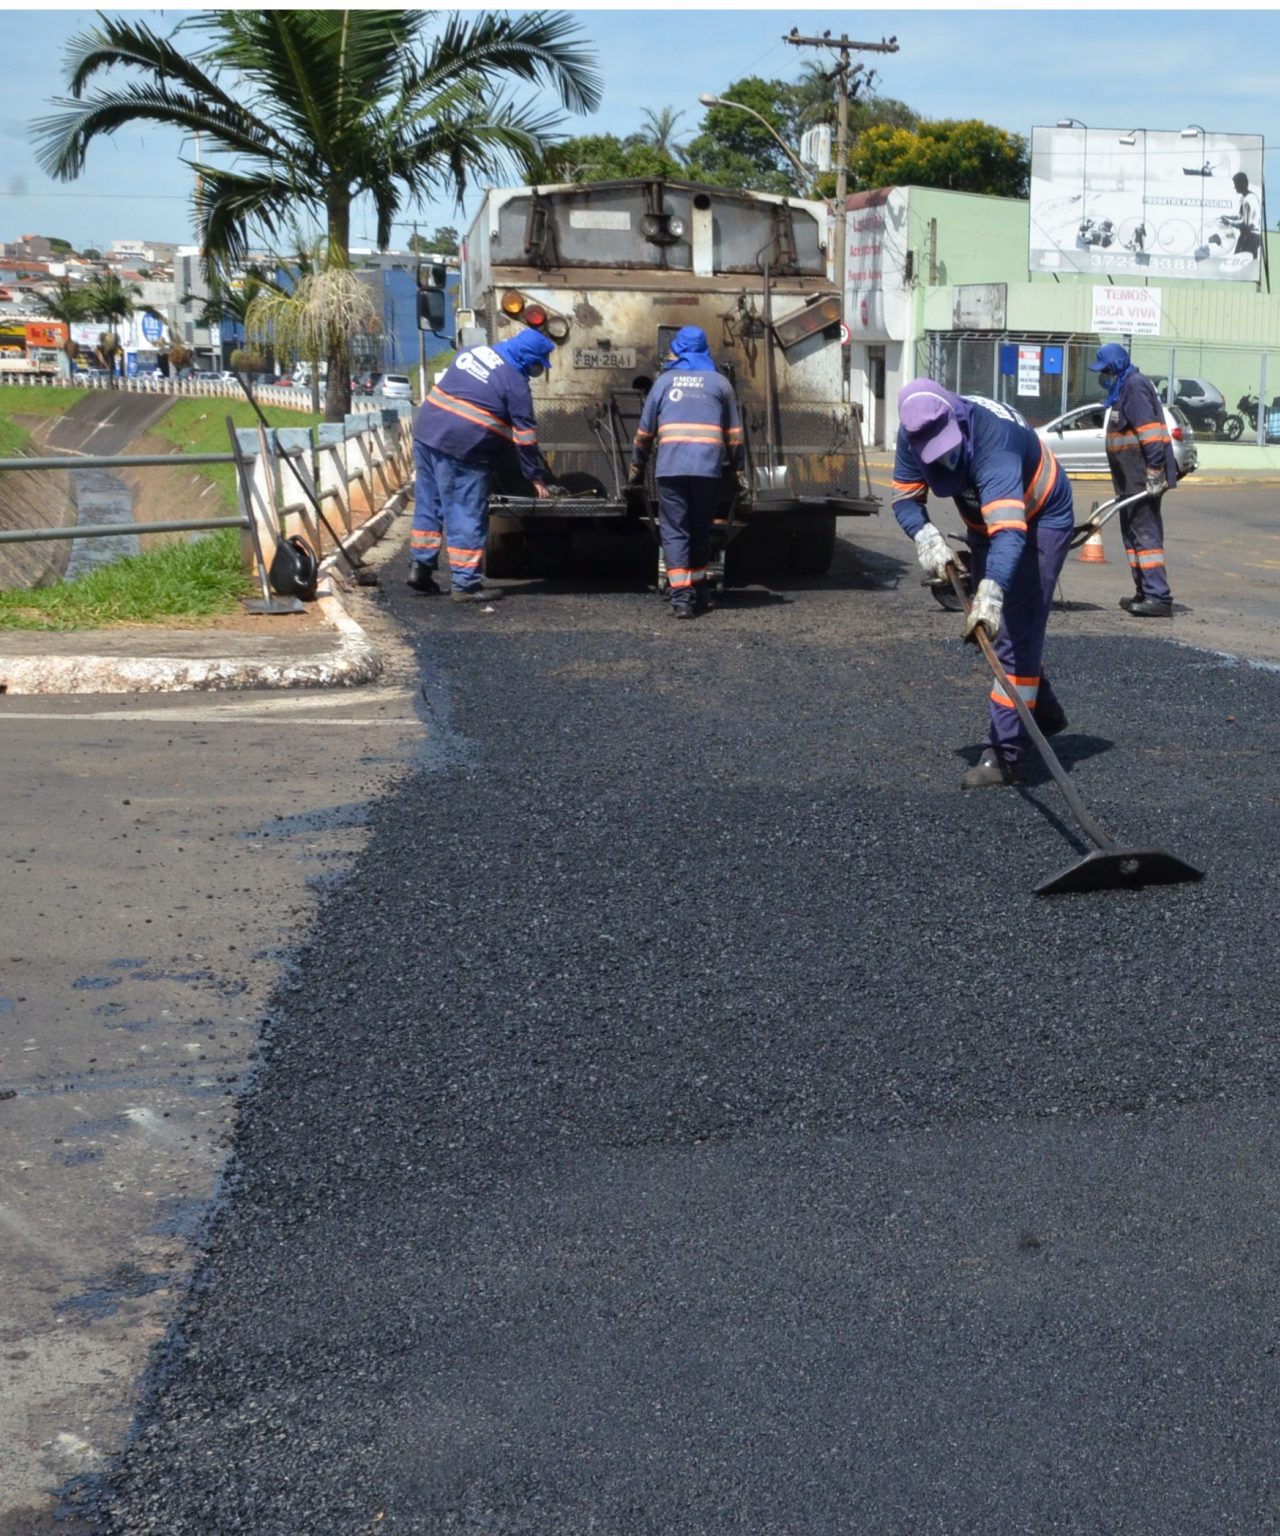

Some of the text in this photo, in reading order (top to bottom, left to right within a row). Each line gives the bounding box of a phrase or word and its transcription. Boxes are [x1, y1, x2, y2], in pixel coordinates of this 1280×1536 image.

[1104, 288, 1148, 302] TEMOS
[1095, 304, 1156, 319] ISCA VIVA
